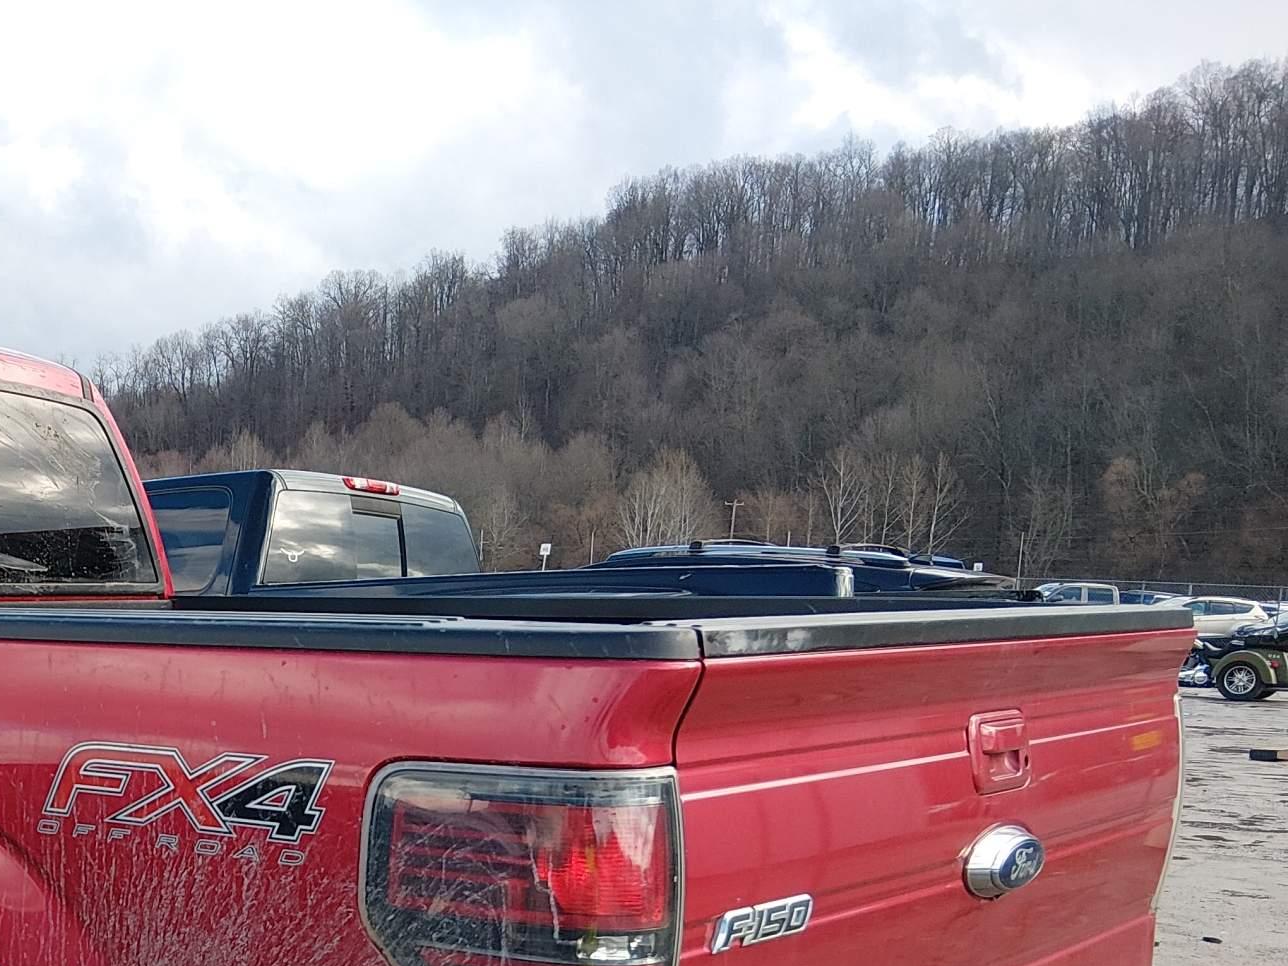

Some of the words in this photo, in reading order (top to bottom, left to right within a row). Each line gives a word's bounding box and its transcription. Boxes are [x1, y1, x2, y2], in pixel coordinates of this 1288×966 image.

[42, 741, 335, 845] FX4
[37, 819, 131, 842] OFF
[155, 835, 306, 866] ROAD
[1010, 846, 1039, 881] Ford
[711, 893, 813, 954] F-150
